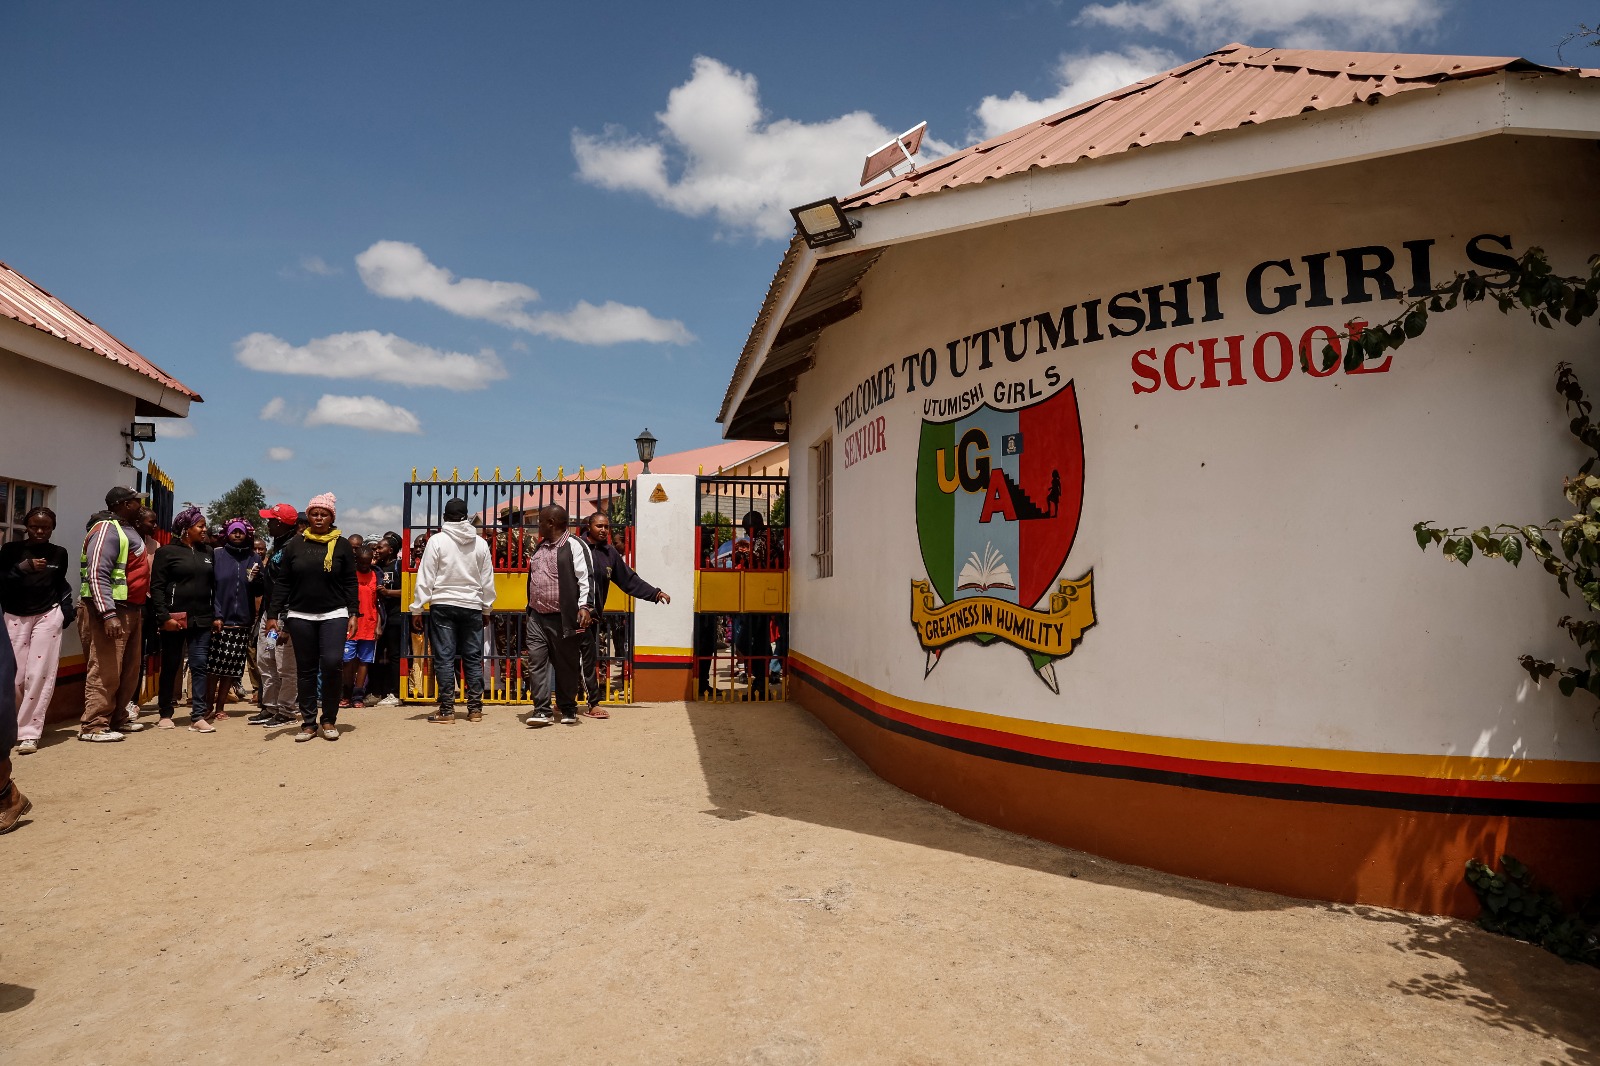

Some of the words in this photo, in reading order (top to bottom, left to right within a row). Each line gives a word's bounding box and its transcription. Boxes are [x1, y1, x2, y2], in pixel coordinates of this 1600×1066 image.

[835, 363, 895, 434] WELCOME
[902, 347, 937, 394] TO
[946, 271, 1224, 377] UTUMISHI
[1245, 233, 1521, 315] GIRLS
[844, 415, 887, 470] SENIOR
[1131, 320, 1393, 395] SCHOOL
[923, 382, 985, 417] UTUMISHI
[993, 365, 1061, 404] GIRLS
[936, 427, 1018, 524] UGA
[925, 604, 979, 641] GREATNESS
[981, 604, 993, 626] IN
[996, 607, 1064, 647] HUMILITY
